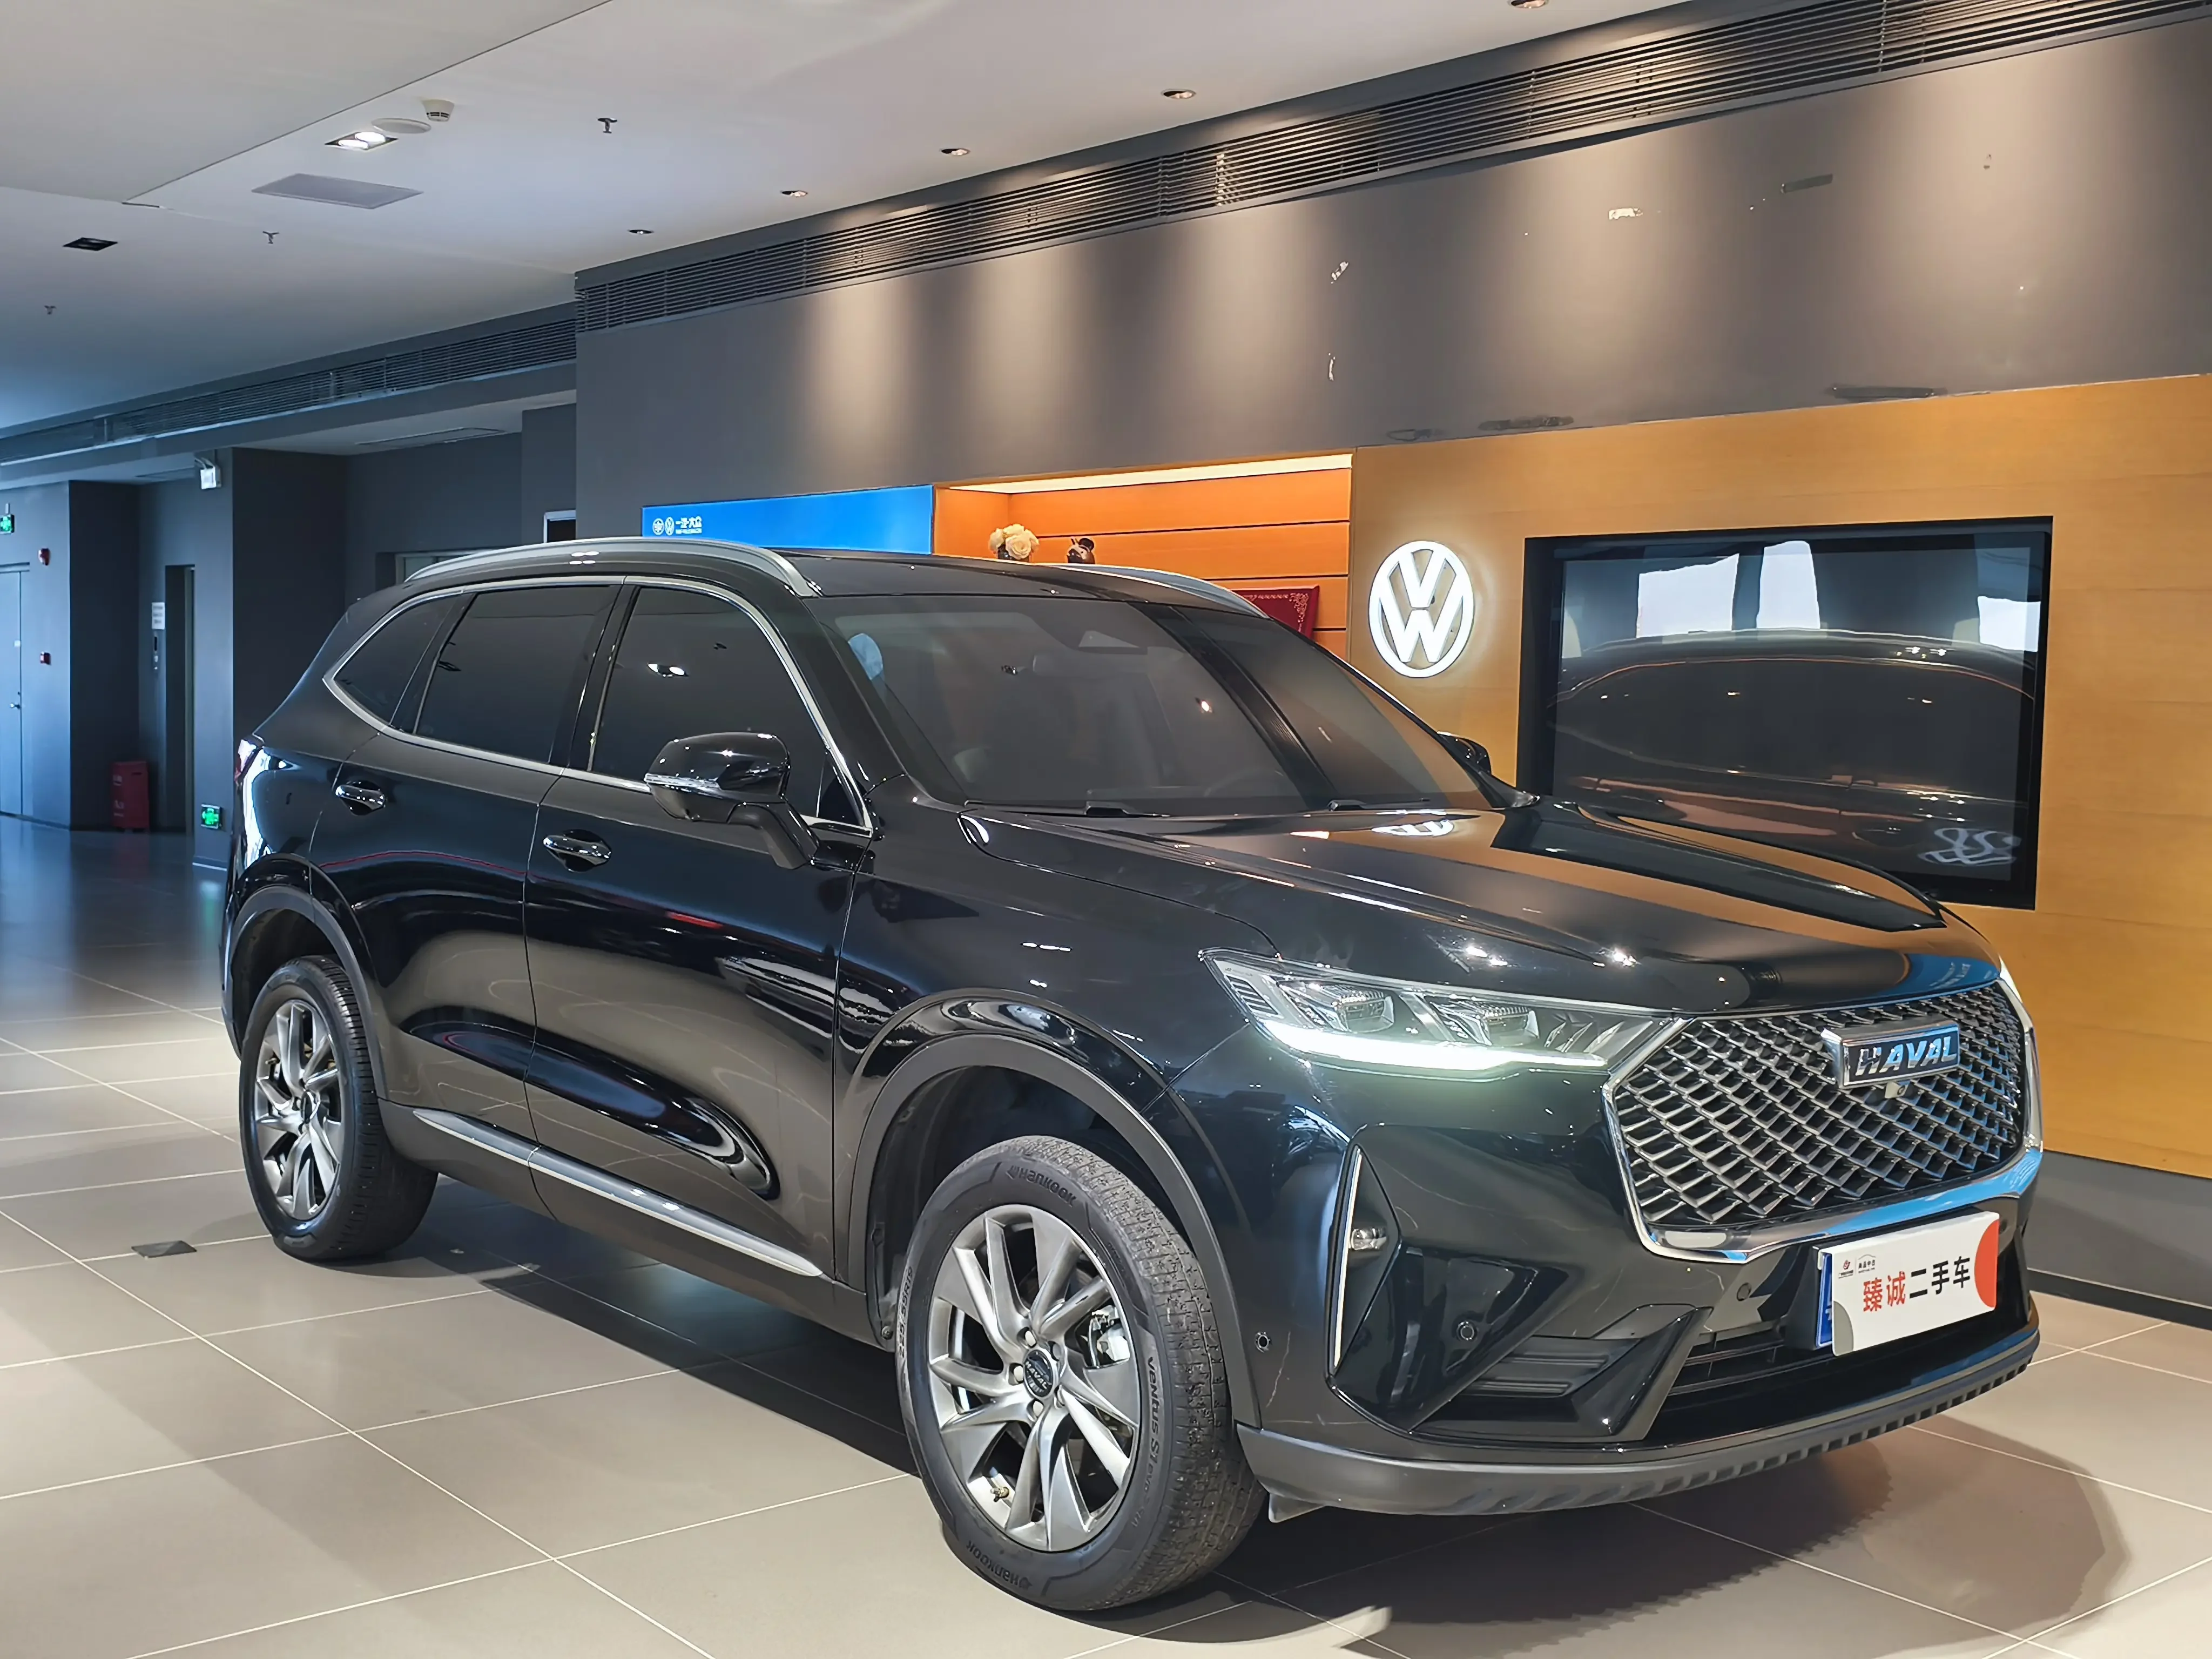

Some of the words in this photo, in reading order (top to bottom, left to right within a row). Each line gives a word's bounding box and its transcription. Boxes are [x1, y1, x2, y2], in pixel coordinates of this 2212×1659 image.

[1370, 541, 1474, 678] VW
[1855, 1036, 1957, 1076] HAVAL
[1863, 1256, 1971, 1312] 臻诚二手车
